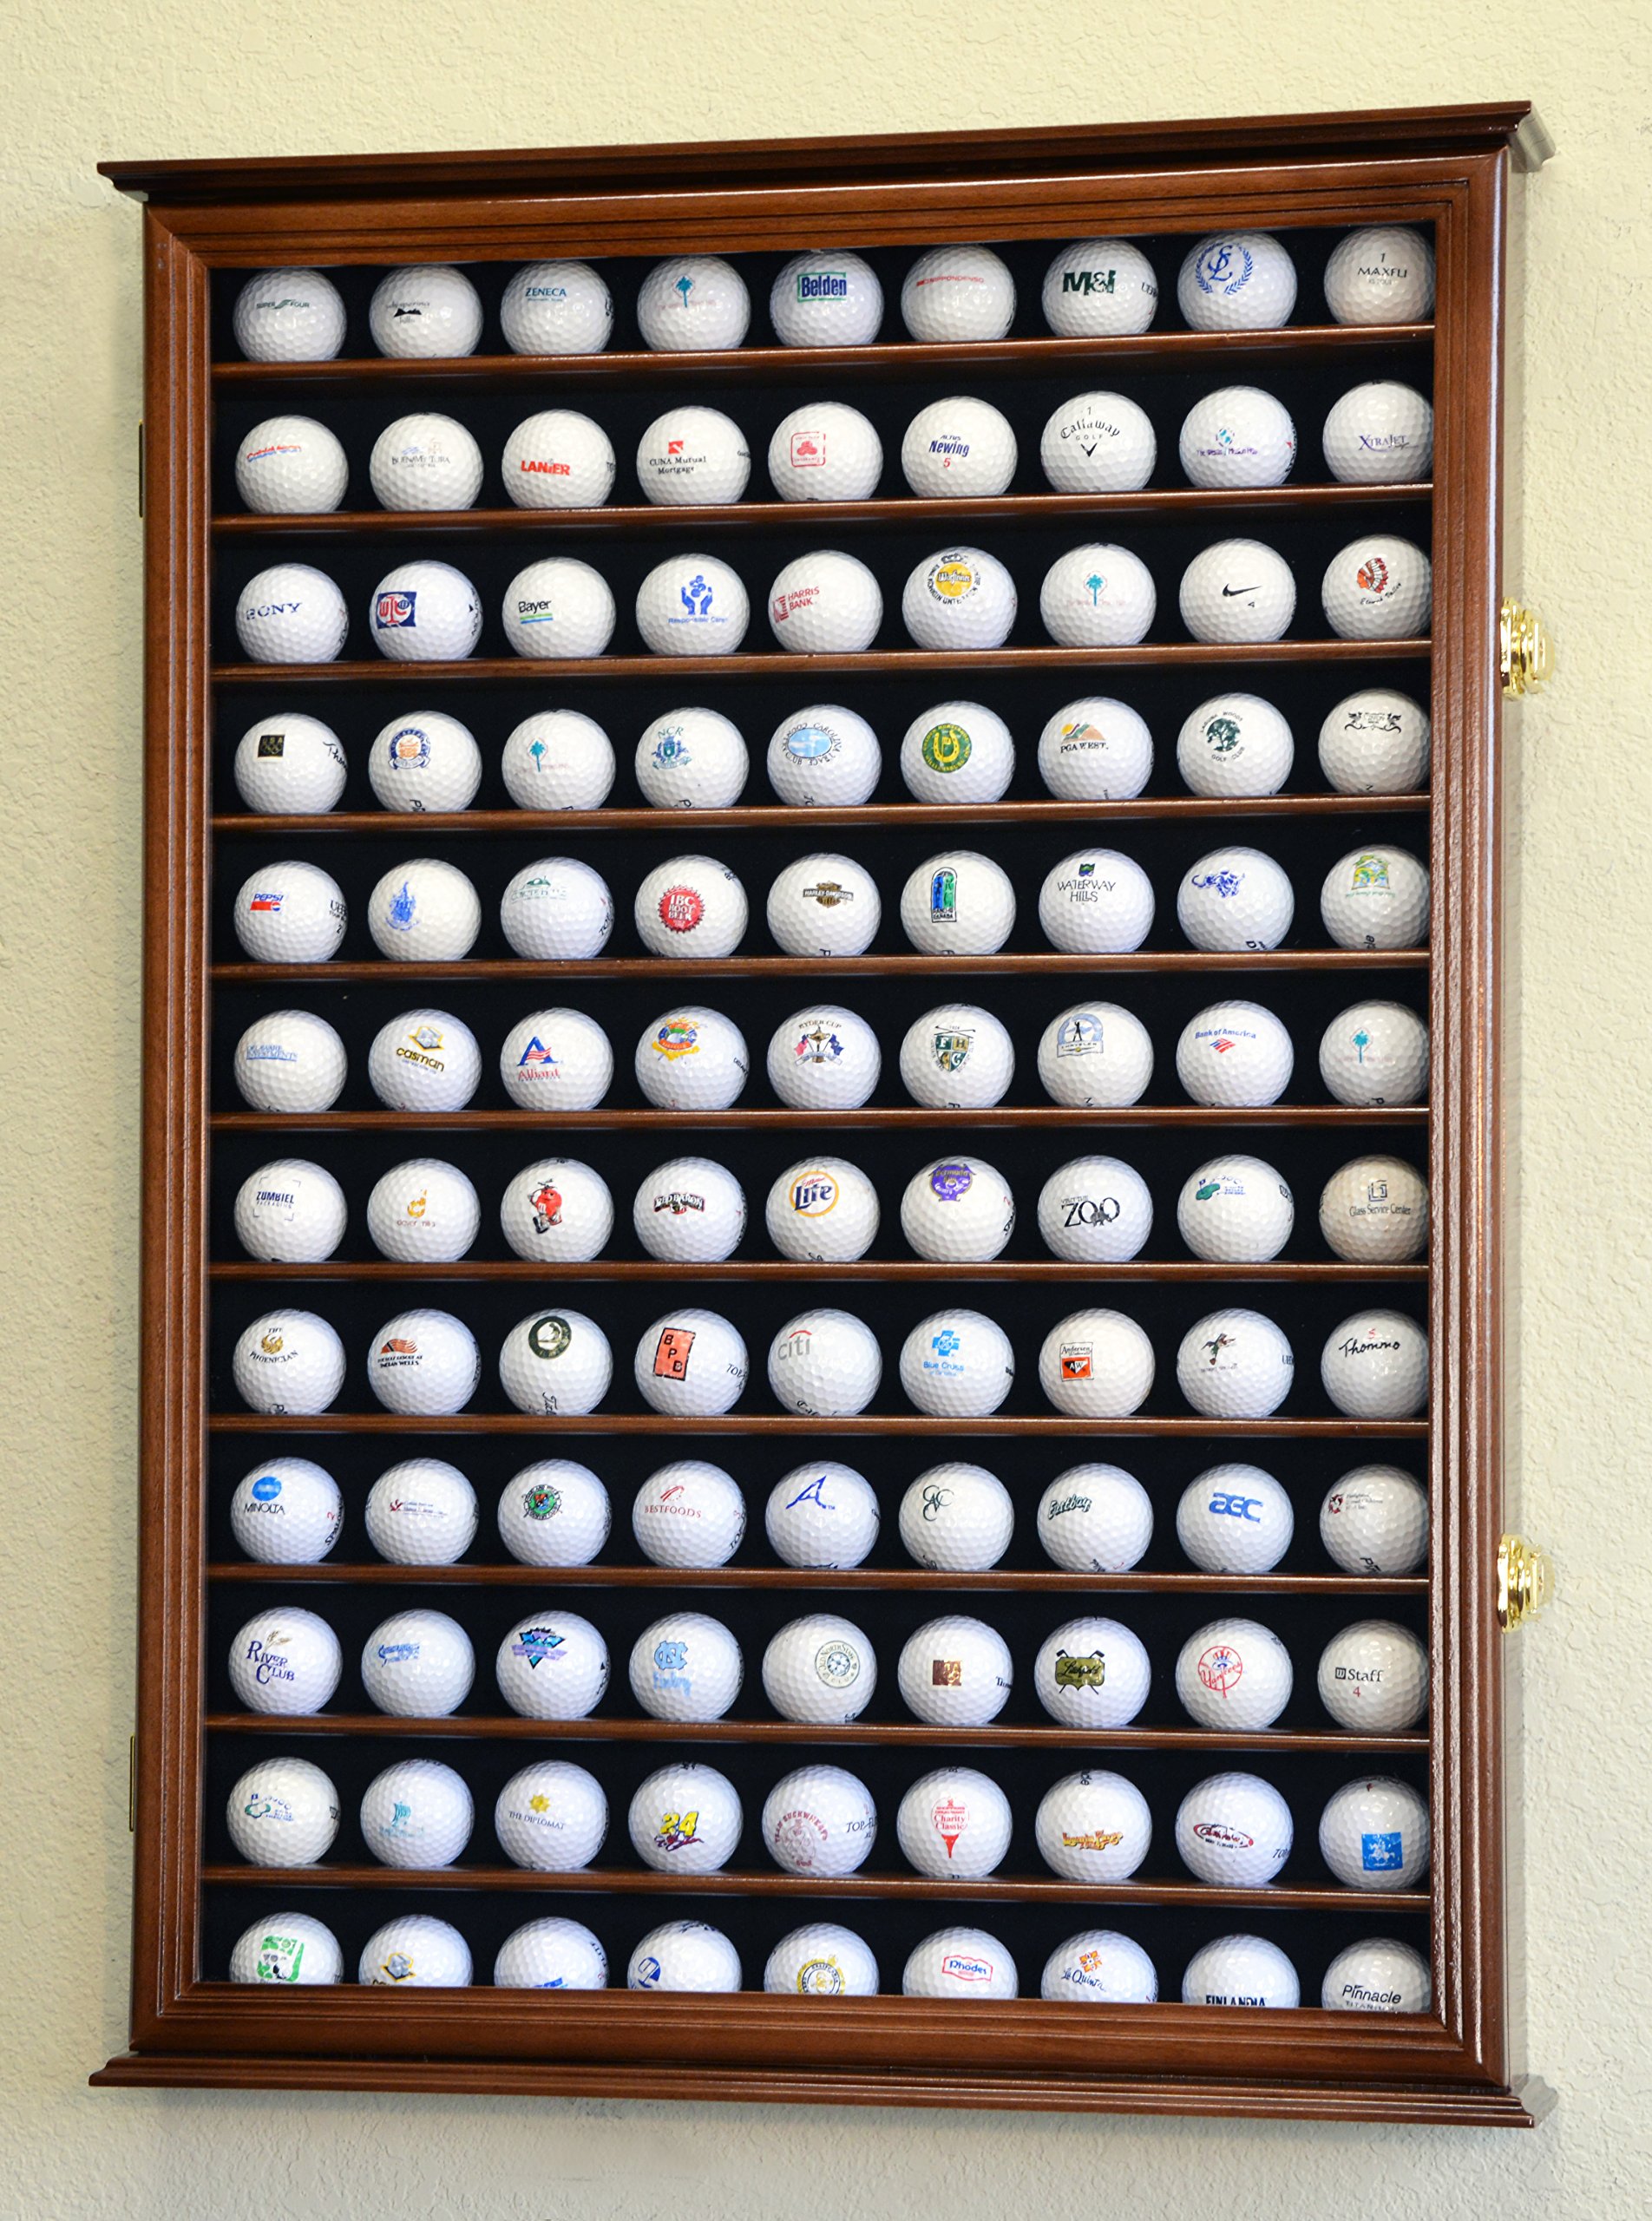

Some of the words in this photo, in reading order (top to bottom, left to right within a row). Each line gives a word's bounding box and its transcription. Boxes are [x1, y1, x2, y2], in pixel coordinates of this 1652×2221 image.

[1380, 252, 1386, 263] 1
[1357, 267, 1407, 278] MAXFLI
[800, 275, 847, 297] Belden
[1062, 269, 1117, 296] M&I
[525, 287, 567, 297] ZENECA
[1060, 419, 1121, 439] Callaway
[929, 441, 970, 457] Newing
[521, 460, 571, 475] LANIER
[649, 458, 672, 467] CUNA
[943, 457, 951, 468] 5
[658, 466, 695, 475] Mortgage
[787, 586, 820, 602] HARRIS
[246, 602, 302, 620] SONY
[518, 599, 552, 614] Bayer
[790, 598, 813, 611] BANK
[658, 726, 684, 738] NCR
[813, 722, 842, 753] CAROLINA
[1060, 744, 1078, 754] PGA
[1211, 753, 1227, 763] GOLF
[1231, 746, 1246, 760] CLUB
[785, 750, 803, 765] CLUB
[1058, 879, 1116, 894] WATERWAY
[671, 894, 695, 906] IBC
[1070, 890, 1098, 902] HILLS
[669, 904, 692, 913] ROOT
[668, 911, 692, 921] BEER
[798, 1020, 824, 1029] RYDER
[825, 1020, 842, 1029] CUP
[1196, 1031, 1213, 1039] Bank
[1223, 1028, 1256, 1039] America
[397, 1046, 445, 1072] casman
[518, 1068, 560, 1078] Alliant
[256, 1191, 294, 1204] ZUMBIEL
[794, 1183, 833, 1211] Lite
[1061, 1196, 1121, 1228] ZOO
[1349, 1205, 1367, 1217] Glass
[1367, 1204, 1389, 1215] Service
[1390, 1202, 1412, 1215] Center
[664, 1334, 673, 1345] B
[668, 1348, 677, 1359] P
[777, 1336, 811, 1360] citi
[1062, 1346, 1091, 1354] Andersen
[249, 1350, 299, 1363] PHOENICIAN
[941, 1361, 964, 1371] Cross
[244, 1504, 285, 1516] MINOLTA
[645, 1505, 702, 1518] BESTFOODS
[1047, 1494, 1092, 1520] Eastbay
[1199, 1662, 1241, 1688] Yankees
[1347, 1669, 1383, 1683] Staff
[1353, 1687, 1361, 1698] 4
[508, 1811, 522, 1820] THE
[523, 1814, 567, 1831] DIPLOMAT
[659, 1812, 699, 1838] 24
[949, 1960, 987, 1975] Rhodes
[1063, 1967, 1072, 1981] La
[1072, 1970, 1106, 1990] Quinta
[1341, 1983, 1402, 2005] Pinnacle
